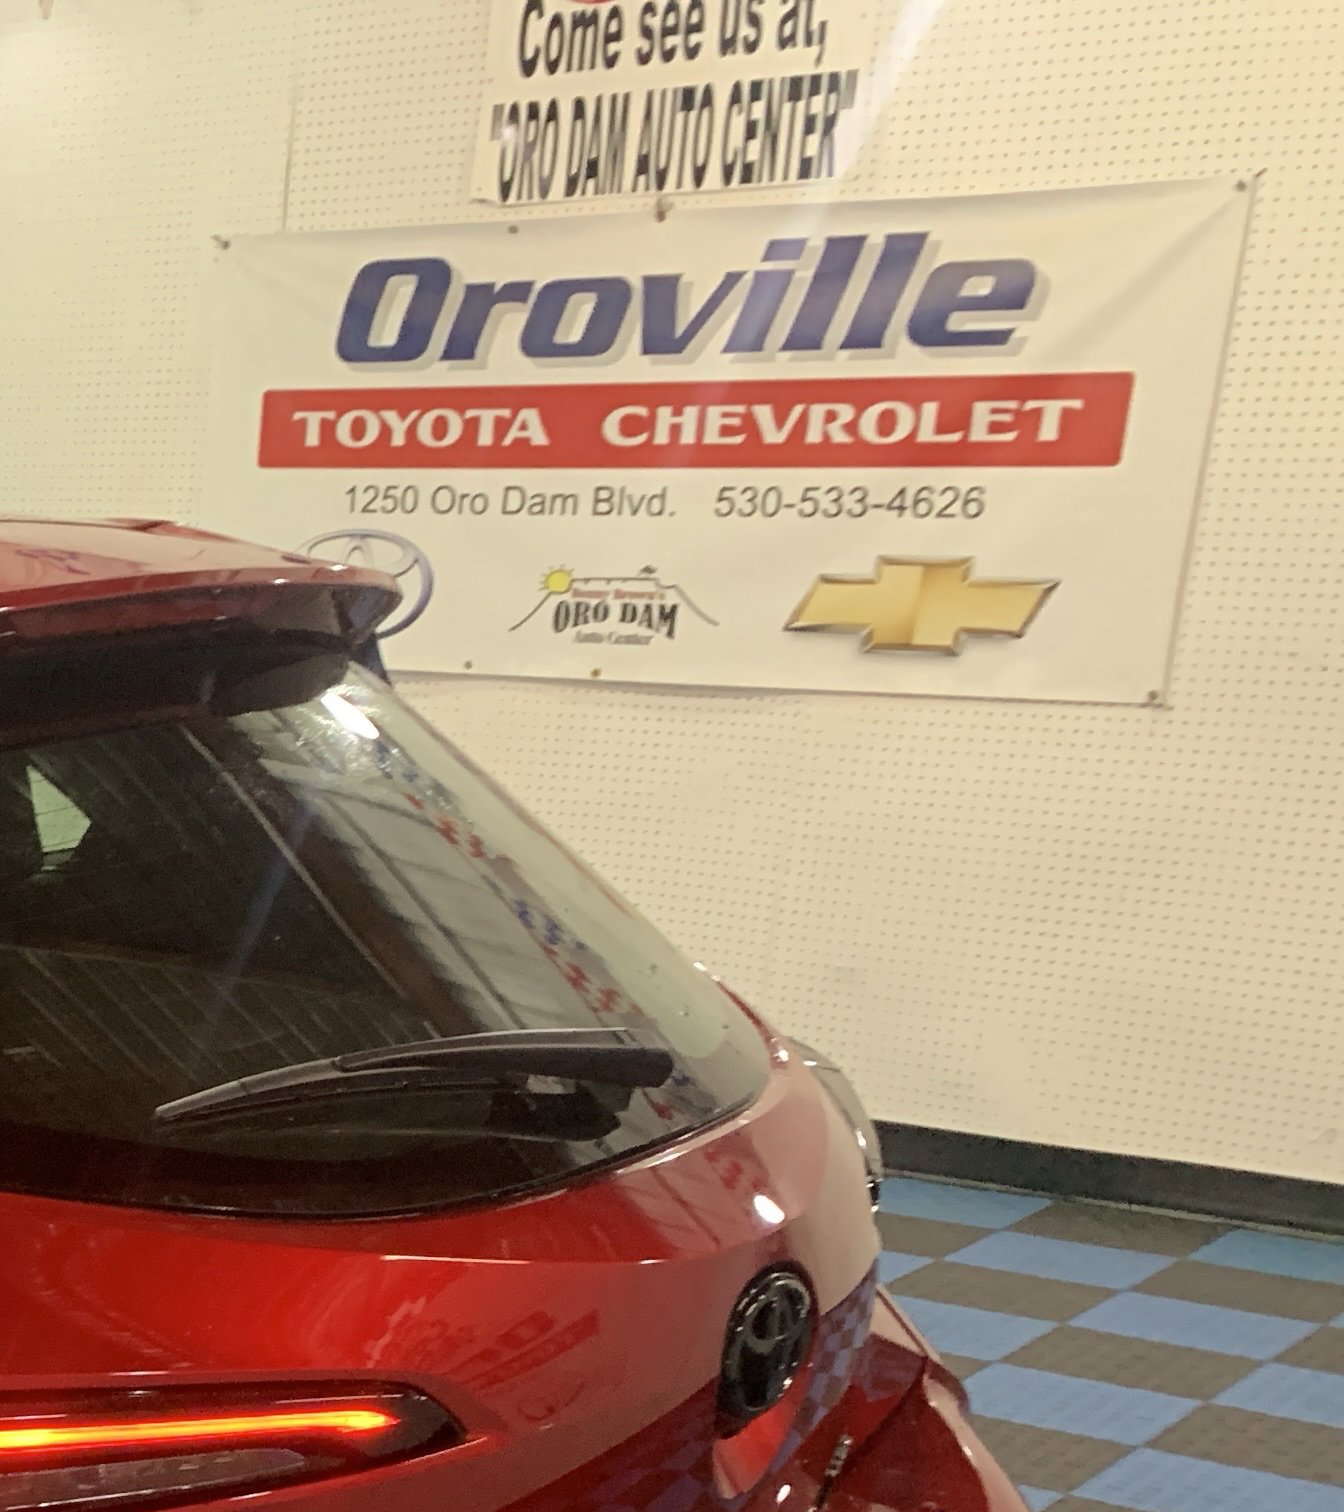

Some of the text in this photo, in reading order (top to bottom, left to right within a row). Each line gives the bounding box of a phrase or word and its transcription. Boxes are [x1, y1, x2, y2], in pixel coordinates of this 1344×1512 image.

[518, 0, 625, 78] Come
[634, 0, 705, 66] see
[719, 0, 765, 57] us
[563, 91, 633, 199] DAM
[631, 81, 716, 193] AUTO
[333, 230, 1040, 364] Oroville
[291, 397, 1086, 448] TOYOTA CHEVROLET
[344, 485, 987, 519] 1250 Oro Dam Blvd. 530-533-4626
[553, 600, 678, 639] ORO DAM
